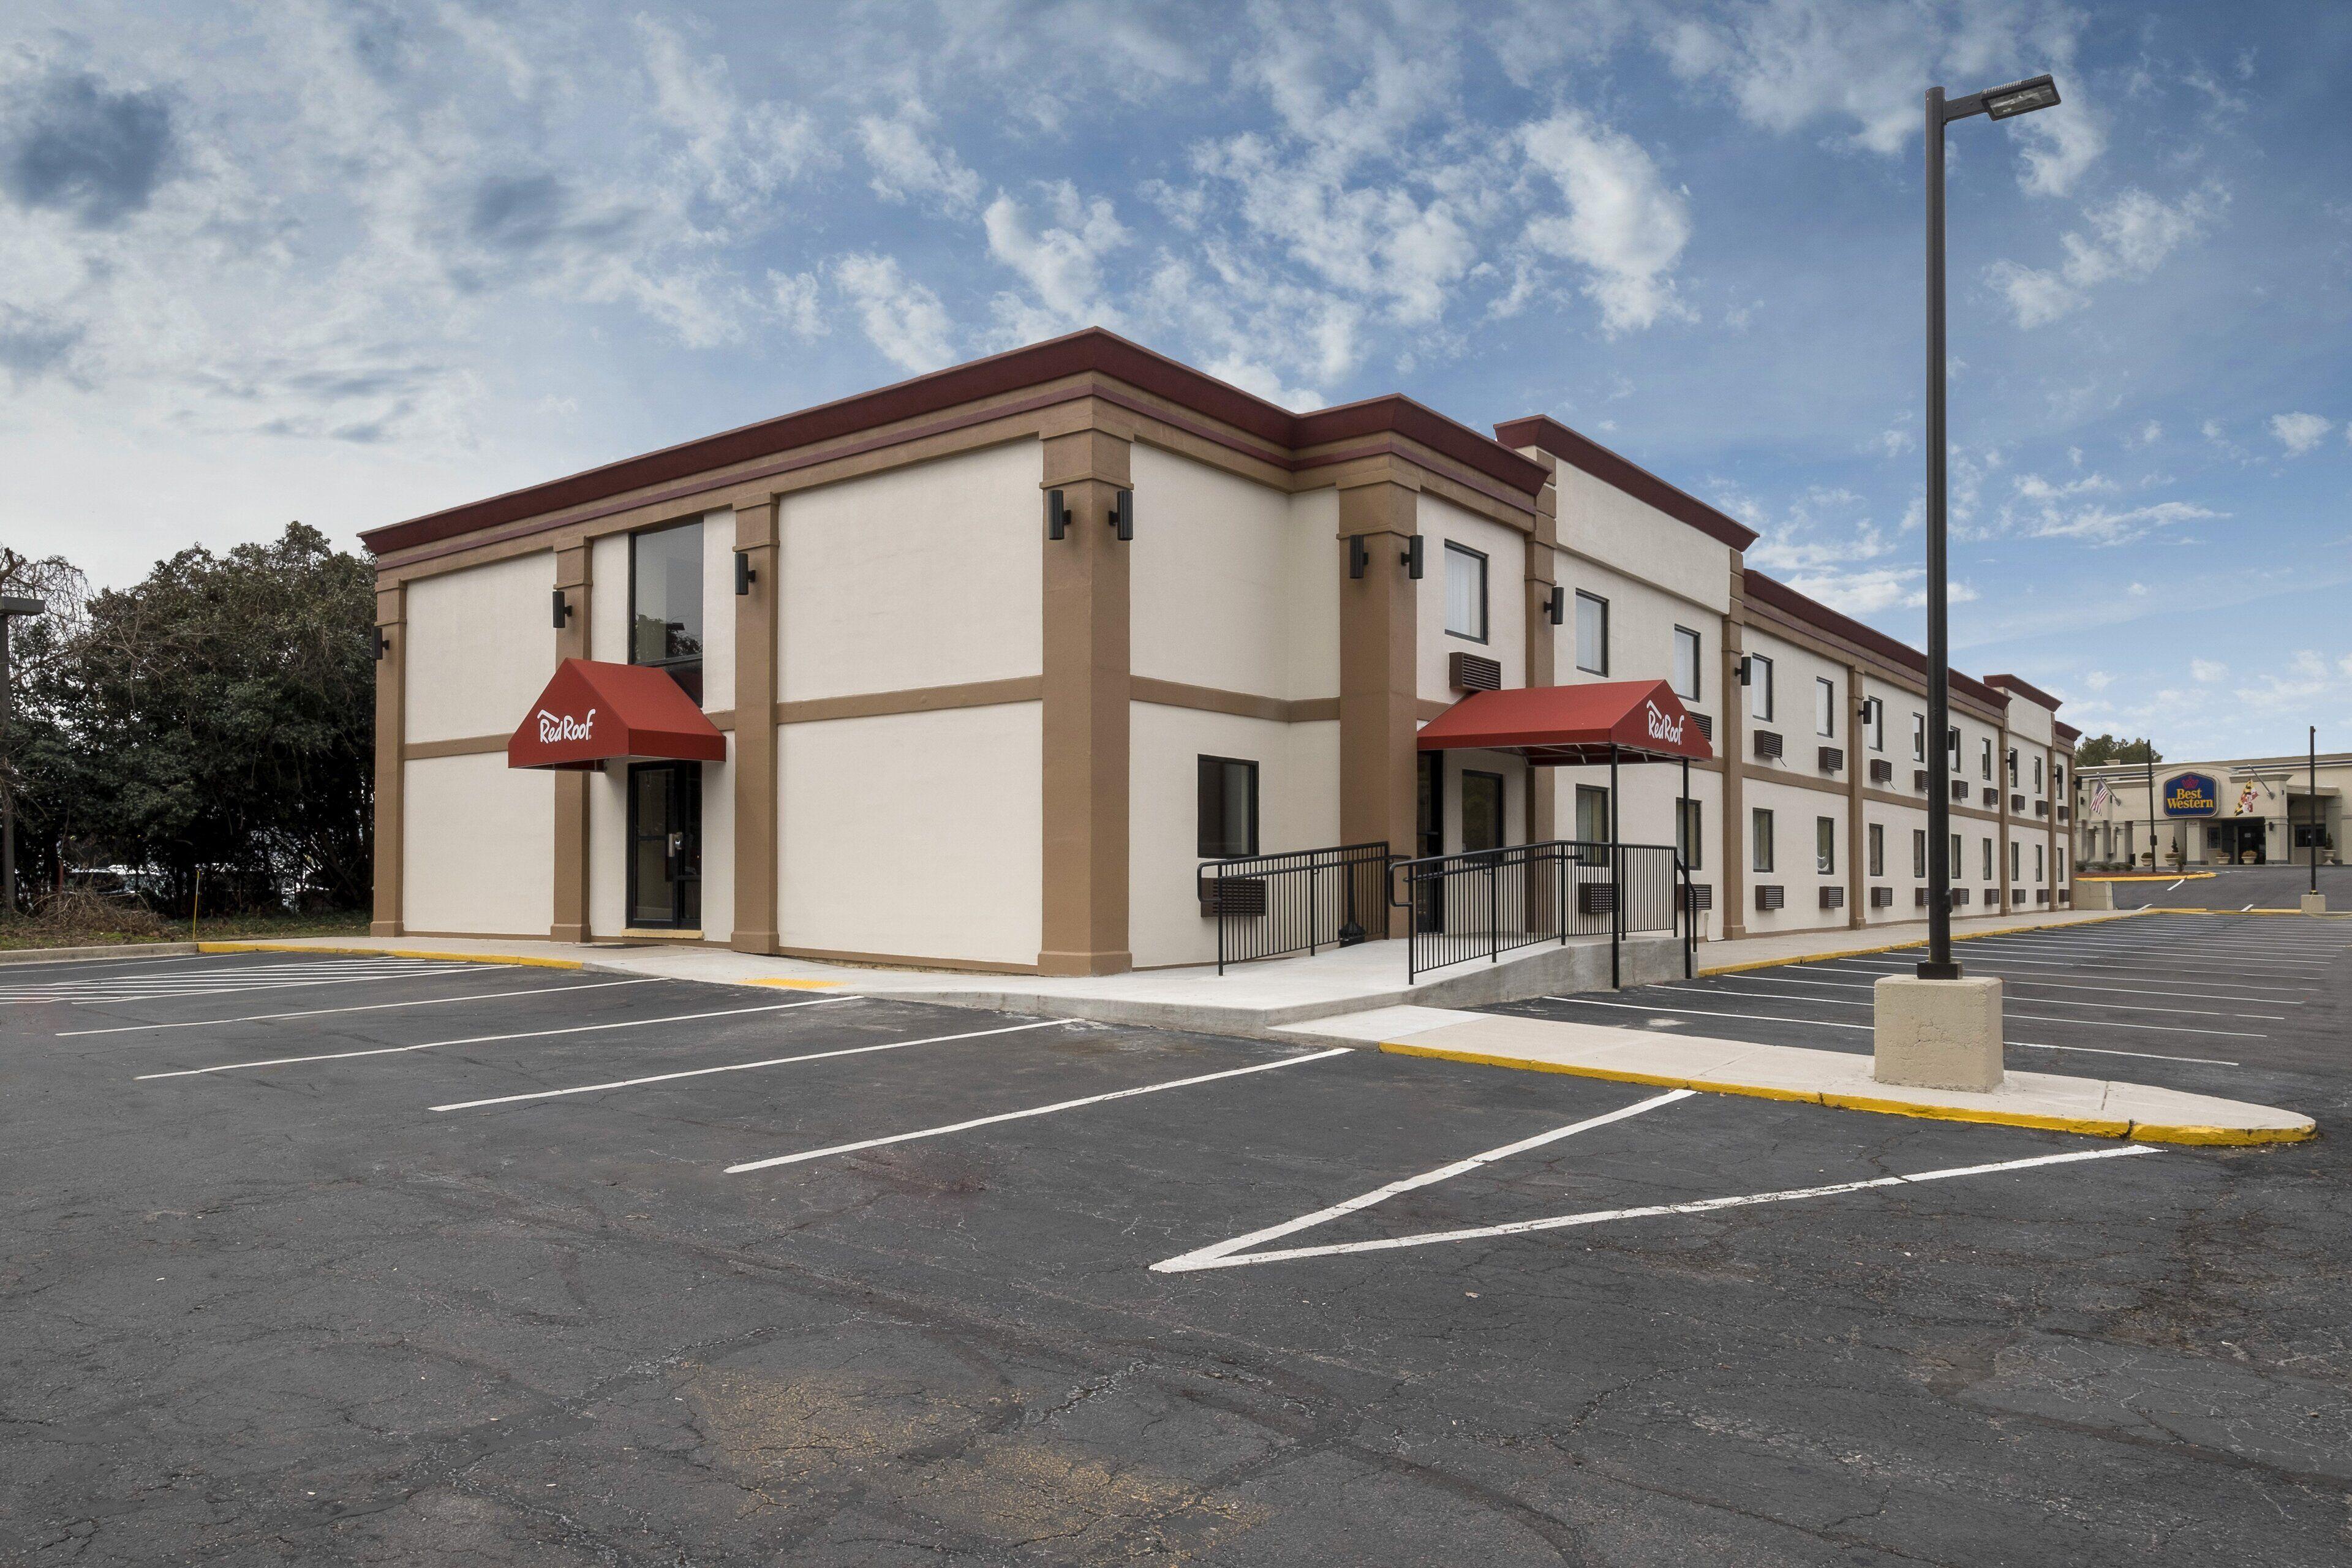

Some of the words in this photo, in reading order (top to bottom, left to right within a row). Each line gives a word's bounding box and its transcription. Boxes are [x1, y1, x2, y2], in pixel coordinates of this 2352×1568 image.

[540, 718, 564, 744] Red
[564, 709, 596, 741] Roof
[1648, 710, 1665, 739] Red
[1665, 714, 1685, 745] Roof
[2166, 797, 2214, 809] Western
[2176, 788, 2203, 800] Best
